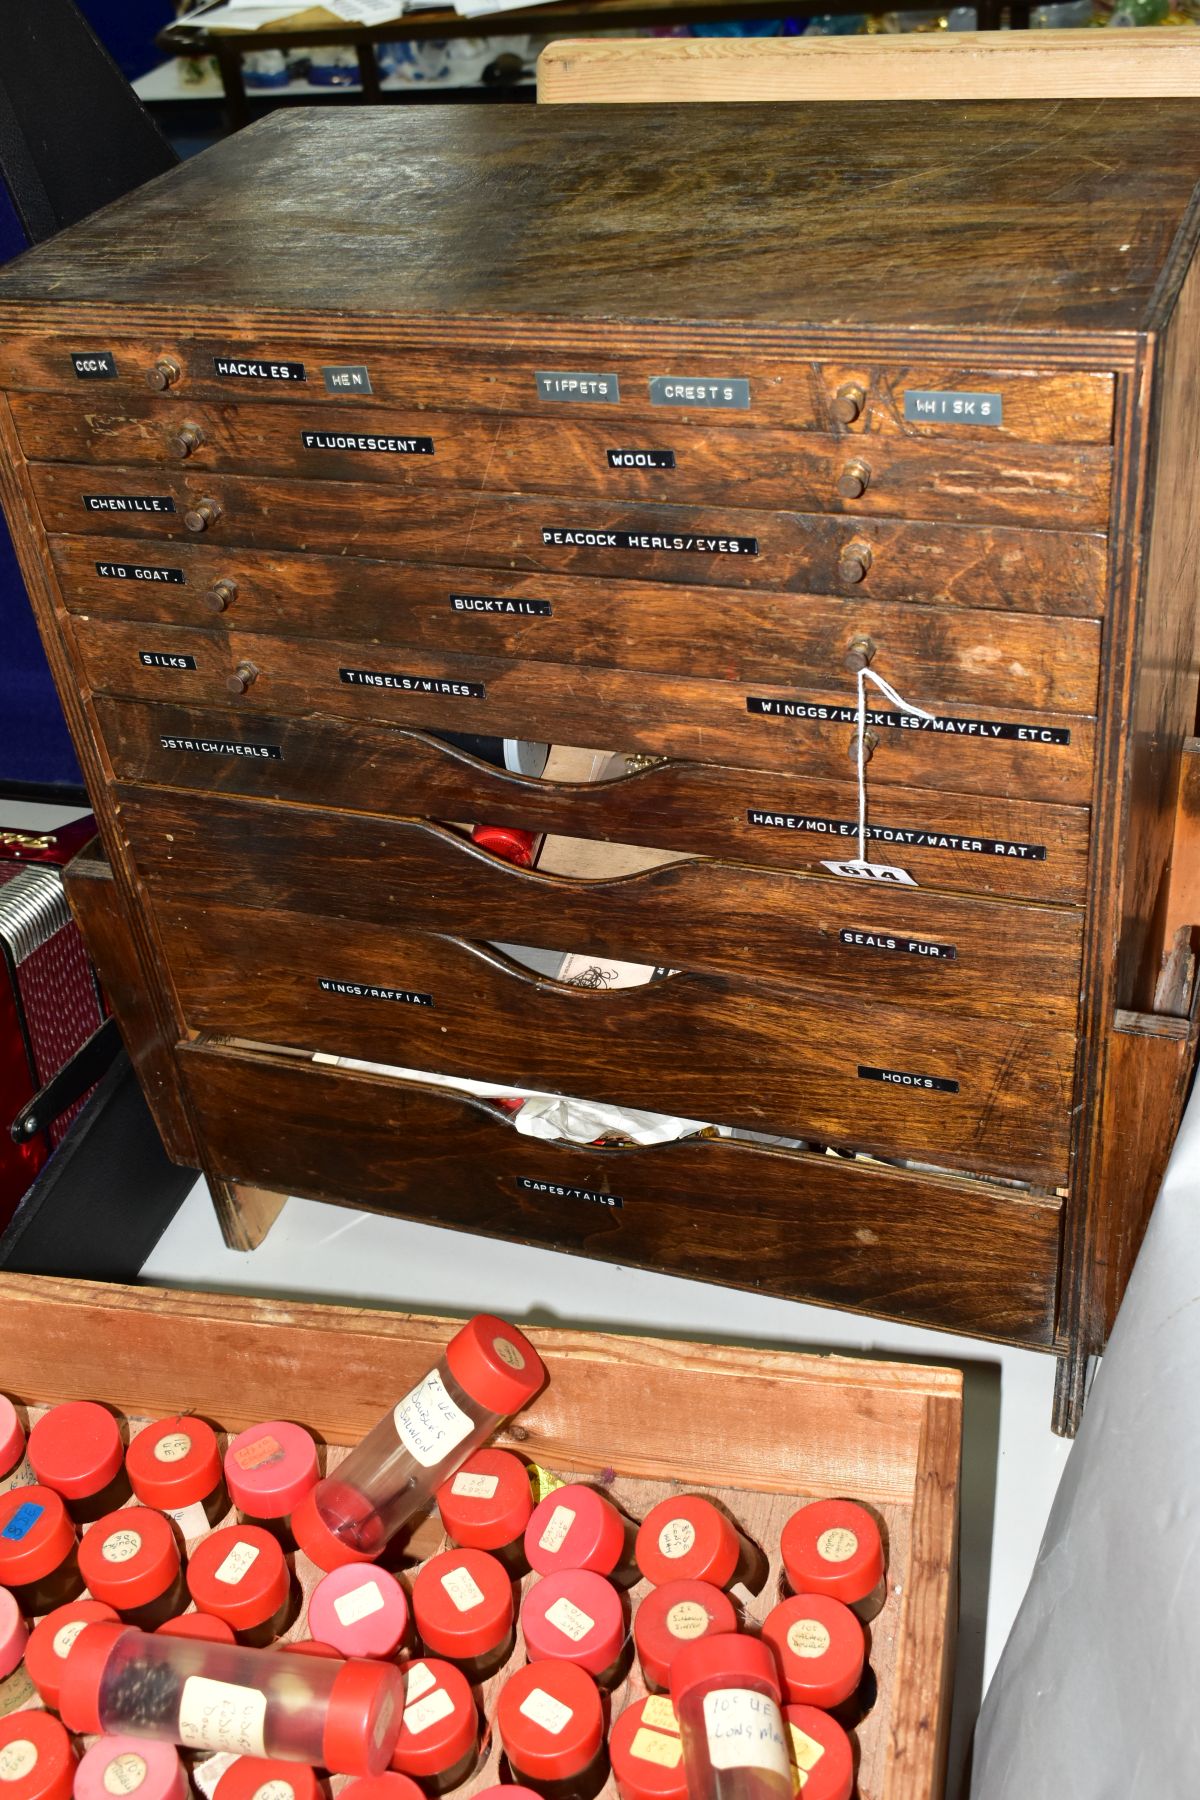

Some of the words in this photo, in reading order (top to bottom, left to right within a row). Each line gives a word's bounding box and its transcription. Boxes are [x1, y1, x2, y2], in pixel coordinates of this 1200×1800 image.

[218, 362, 298, 379] HACKLES.
[331, 373, 362, 386] HEN
[665, 386, 734, 400] CRESTS
[306, 436, 427, 452] FLUORESCENT.
[612, 454, 667, 467] WOOL.
[90, 499, 169, 511] CHENILLE.
[543, 532, 617, 546] PEACOCK
[629, 536, 750, 552] HERLS/EYES.
[100, 566, 127, 577] KID
[135, 569, 178, 581] GOAT.
[454, 599, 544, 614] BUCKTAIL.
[143, 655, 187, 667] SILKS
[347, 672, 478, 696] TINSELS/WIRES.
[1018, 728, 1061, 743] ETC.
[995, 844, 1037, 859] RAT.
[844, 933, 896, 949] SEALS
[909, 943, 947, 957] FUR.
[321, 981, 427, 1004] WINGS/RAFFIA.
[523, 1180, 615, 1206] CAPES/TAILS
